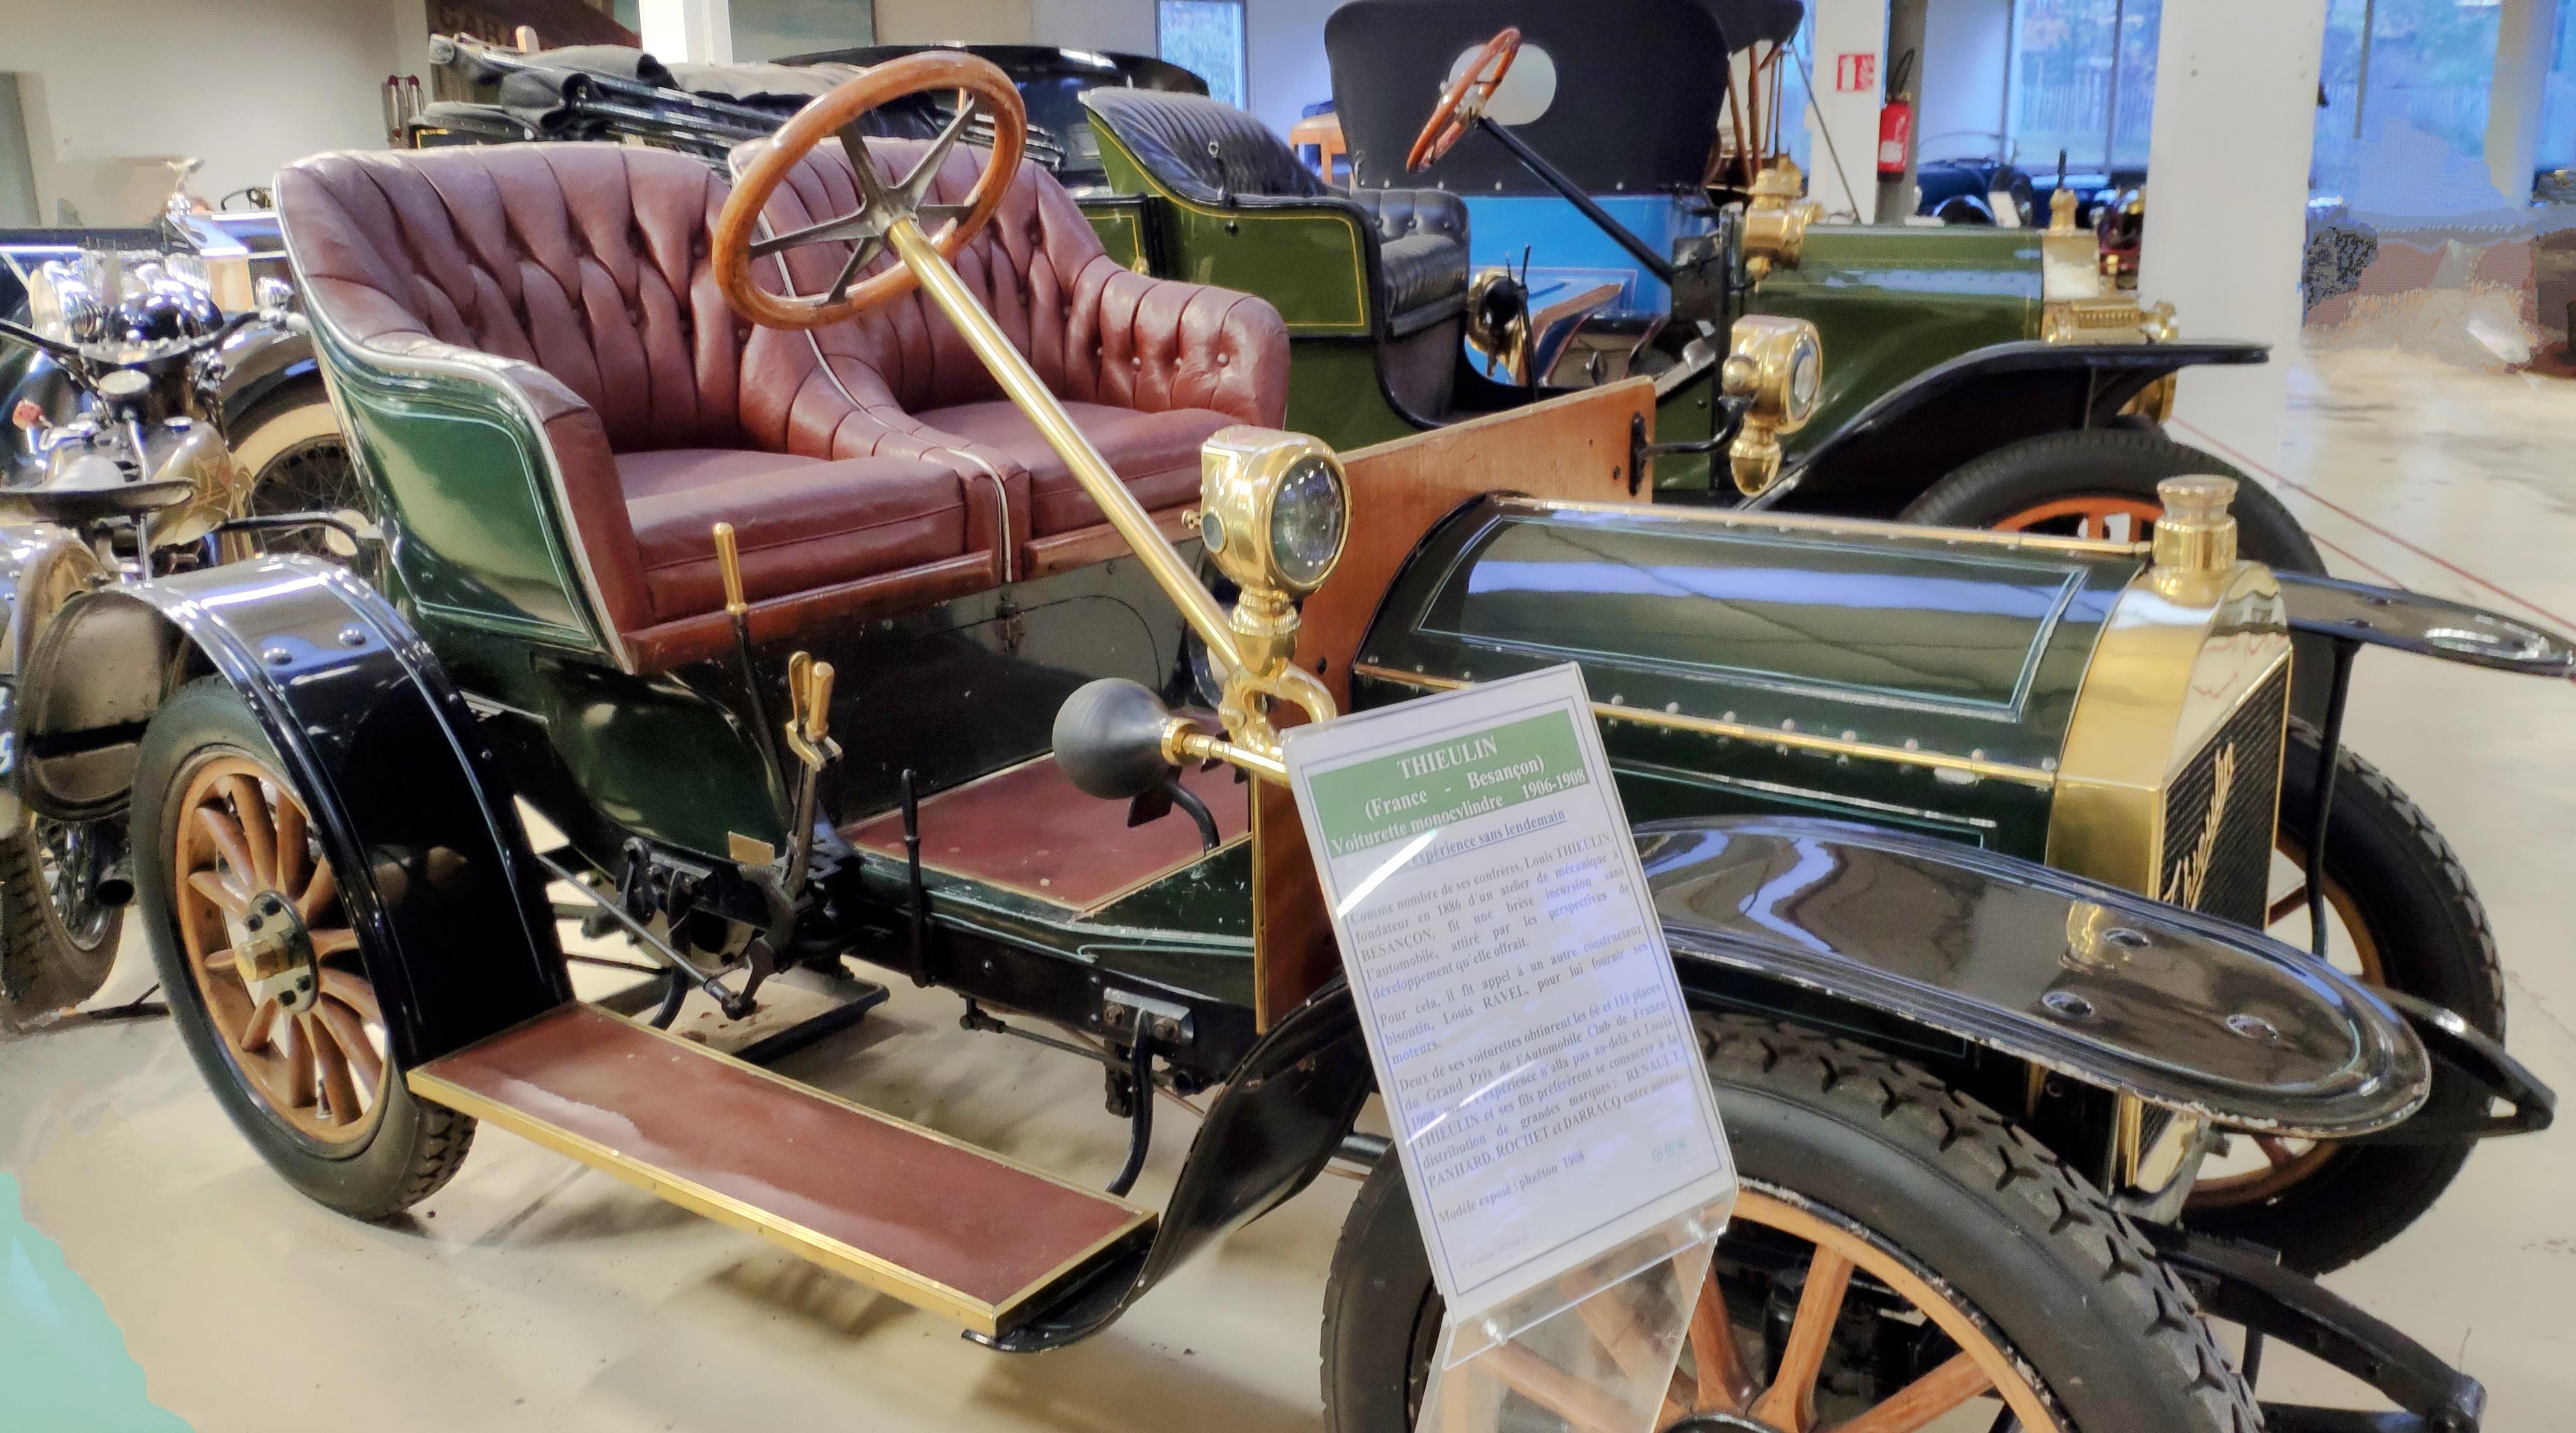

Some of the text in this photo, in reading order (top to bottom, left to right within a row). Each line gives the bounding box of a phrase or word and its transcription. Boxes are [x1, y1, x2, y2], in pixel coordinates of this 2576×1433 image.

[1364, 790, 1429, 822] (France
[1467, 753, 1546, 789] Besançon)
[1396, 736, 1499, 779] THIEULIN
[1332, 824, 1407, 854] Voiturette
[1522, 768, 1586, 798] 1906-1908
[1479, 829, 1503, 843] sans
[1505, 810, 1565, 835] lendemain
[1350, 904, 1395, 924] Comme
[1398, 890, 1439, 909] nombre
[1441, 883, 1453, 895] de
[1456, 879, 1471, 890] ses
[1475, 864, 1523, 883] confrères,
[1525, 852, 1553, 867] Louis
[1355, 919, 1411, 943] fondateur
[1418, 911, 1430, 923] en
[1437, 899, 1461, 915] 1886
[1468, 892, 1493, 906] d'un
[1501, 880, 1530, 895] atelier
[1536, 872, 1549, 883] de
[1556, 854, 1607, 876] mécanique
[1362, 867, 1624, 961] BESANÇON, fit une brève incursion sans
[1366, 883, 1630, 981] l'automobile, attiré par les perspectives de
[1372, 938, 1529, 999] développement qu'elle offrait.
[1380, 1010, 1407, 1026] Pour
[1416, 998, 1441, 1013] cela,
[1446, 989, 1454, 1002] il
[1461, 984, 1474, 997] fit
[1482, 969, 1510, 990] appel
[1530, 960, 1544, 971] un
[1551, 949, 1577, 964] autre
[1585, 925, 1642, 952] constructeur
[1385, 941, 1648, 1045] bisontin, Louis RAVEL, pour lui fournir ses
[1392, 1040, 1441, 1064] moteurs.
[1400, 1074, 1428, 1091] Deux
[1431, 1066, 1446, 1079] de
[1448, 1059, 1465, 1073] ses
[1469, 1037, 1522, 1064] voiturettes
[1525, 1016, 1572, 1042] obtinrent
[1573, 1012, 1586, 1023] les
[1603, 1000, 1612, 1012] et
[1633, 983, 1661, 1003] places
[1404, 1001, 1667, 1111] du Grand Prix de l'Automobile Club de France
[1542, 1059, 1569, 1076] n'alla
[1573, 1050, 1590, 1067] pas
[1594, 1032, 1629, 1055] au-delà
[1632, 1028, 1641, 1040] et
[1645, 1016, 1672, 1033] Louis
[1418, 1113, 1480, 1148] THIEULIN
[1484, 1108, 1494, 1121] et
[1499, 1102, 1514, 1115] ses
[1518, 1092, 1534, 1106] fils
[1538, 1068, 1592, 1102] préférèrent
[1596, 1064, 1605, 1074] se
[1610, 1044, 1654, 1068] consacrer
[1667, 1033, 1678, 1044] la
[1423, 1135, 1486, 1168] distribution
[1495, 1124, 1510, 1137] de
[1521, 1104, 1560, 1130] grandes
[1570, 1083, 1611, 1106] marques
[1497, 1126, 1549, 1158] ROCHET
[1553, 1122, 1562, 1134] et
[1564, 1096, 1621, 1128] DARRACQ
[1624, 1087, 1648, 1103] entre
[1439, 1201, 1476, 1224] Modèle
[1480, 1182, 1512, 1206] exposé
[1520, 1165, 1558, 1191] phaëton
[1563, 1150, 1585, 1168] 1908
